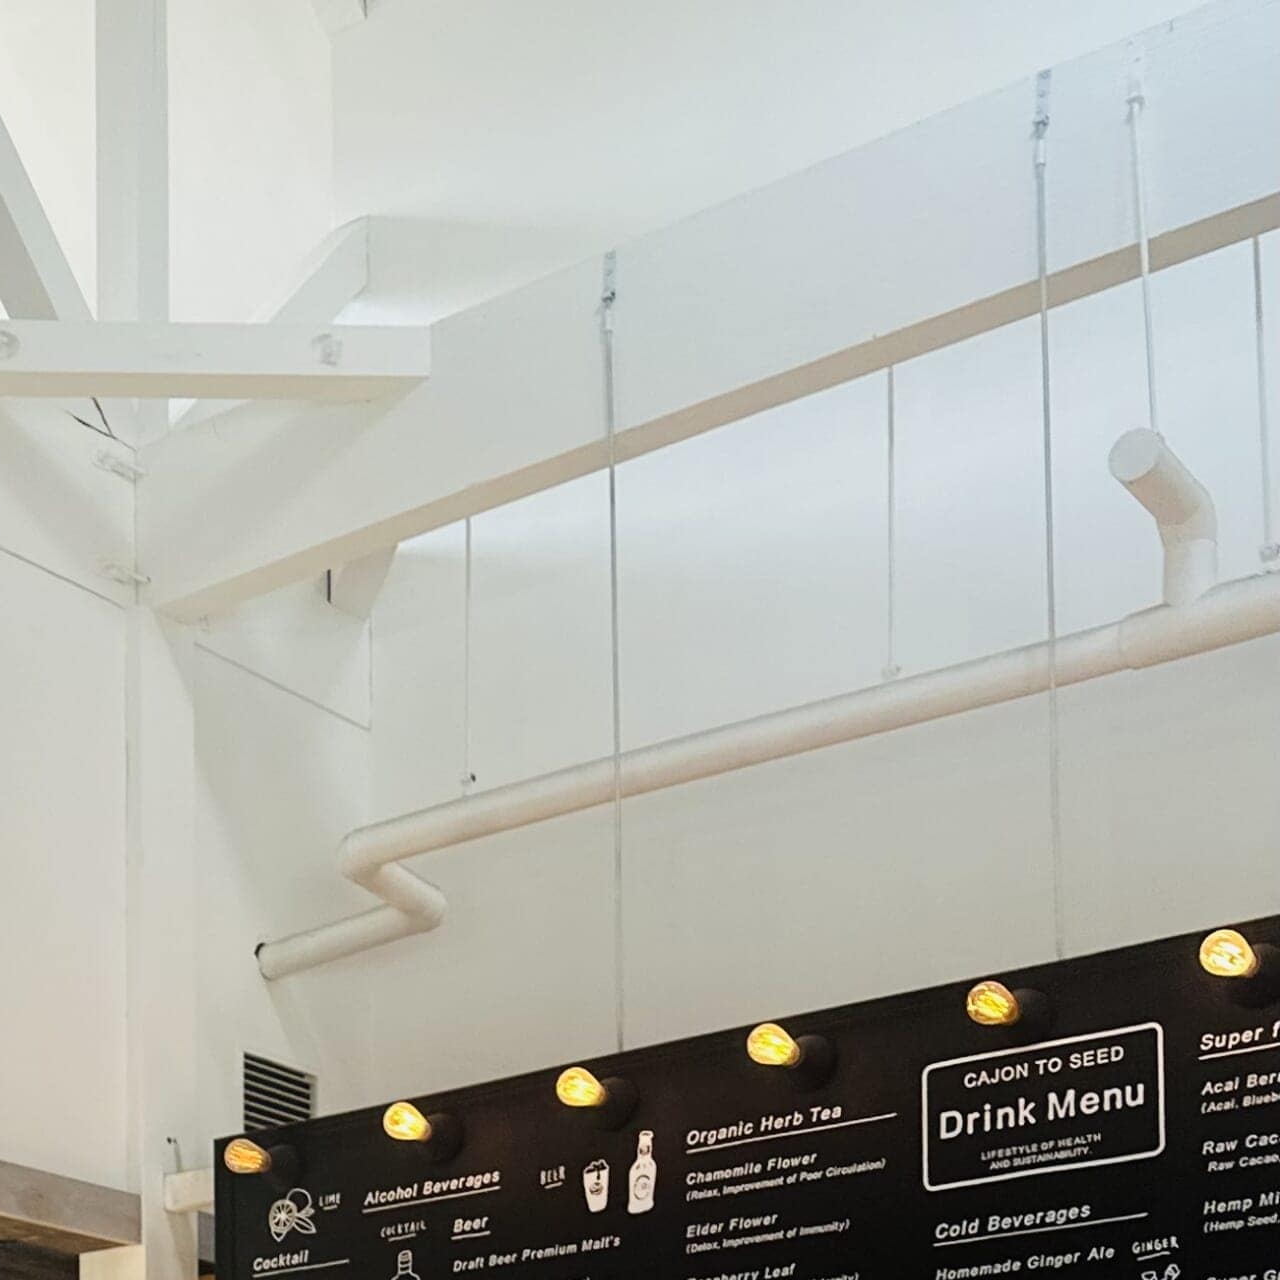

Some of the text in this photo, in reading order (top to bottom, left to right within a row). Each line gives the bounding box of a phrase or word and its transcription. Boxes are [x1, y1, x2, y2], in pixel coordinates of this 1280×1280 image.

[1199, 1027, 1264, 1051] Super
[963, 1045, 1124, 1088] CAJON TO SEED
[939, 1083, 1144, 1140] Drink Menu
[686, 1105, 842, 1145] Organic Herb Tea
[980, 1132, 1101, 1161] LIFESTYLE OF HEALTH
[1201, 1139, 1238, 1155] Raw
[540, 1165, 565, 1185] BEER
[685, 1152, 817, 1185] Chamomile Flower
[1207, 1160, 1235, 1172] Raw
[363, 1170, 500, 1206] Alcohol Beverages
[318, 1192, 341, 1209] LIME
[1203, 1198, 1253, 1215] Hemp
[380, 1220, 426, 1238] COCKTAIL
[452, 1216, 491, 1235] Beer
[685, 1213, 778, 1238] Elder Flower
[935, 1204, 1091, 1239] Cold Beverages
[1203, 1212, 1280, 1233] (Hemp Seed,
[1131, 1235, 1179, 1254] GINGER
[252, 1249, 309, 1271] Cocktail
[452, 1256, 484, 1272] Draft
[488, 1252, 517, 1267] Beer
[521, 1243, 577, 1261] Premium
[1026, 1251, 1081, 1269] Ginger
[1086, 1246, 1115, 1261] Ale
[763, 1262, 796, 1279] Leaf
